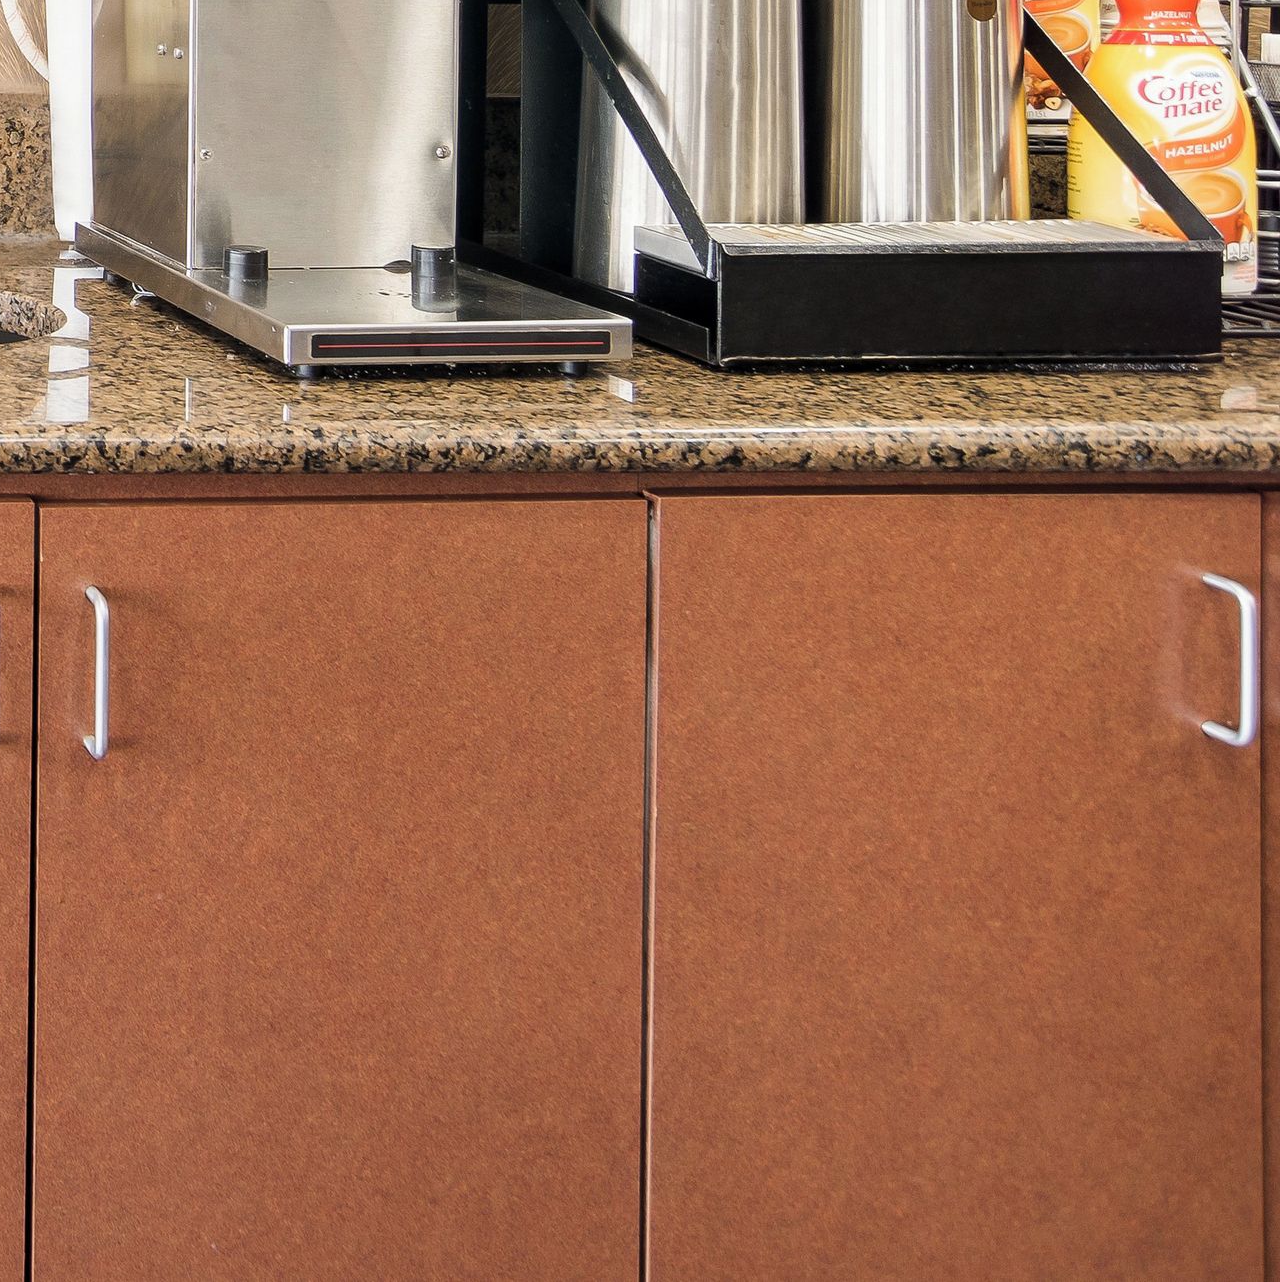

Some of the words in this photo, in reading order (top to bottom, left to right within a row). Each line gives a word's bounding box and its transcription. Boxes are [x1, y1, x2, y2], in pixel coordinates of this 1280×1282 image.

[1150, 10, 1192, 19] HAZELNUT
[1137, 75, 1224, 105] Coffee
[1164, 97, 1224, 119] mate
[1165, 133, 1233, 159] HAZELNUT
